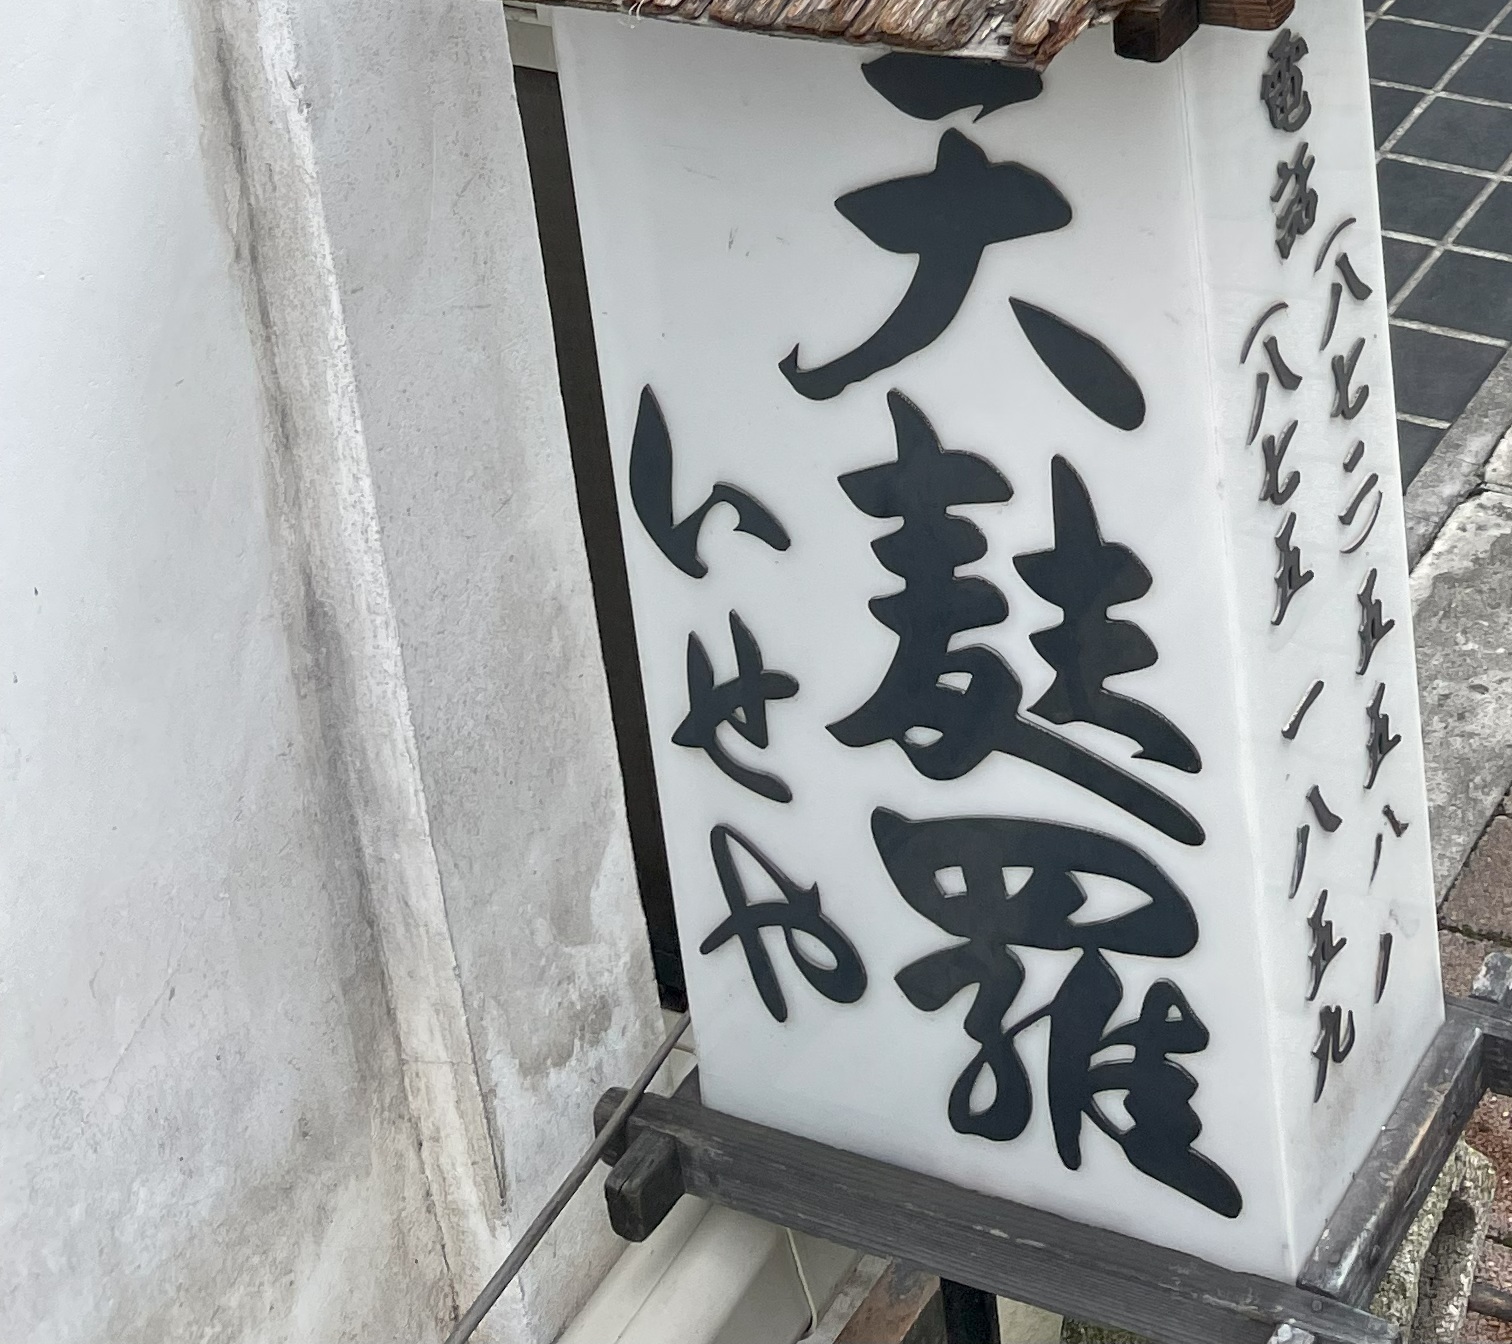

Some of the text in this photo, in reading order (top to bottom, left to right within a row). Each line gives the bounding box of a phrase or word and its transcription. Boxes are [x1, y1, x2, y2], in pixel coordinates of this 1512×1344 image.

[1260, 23, 1320, 260] 電話
[628, 383, 868, 1024] いせや
